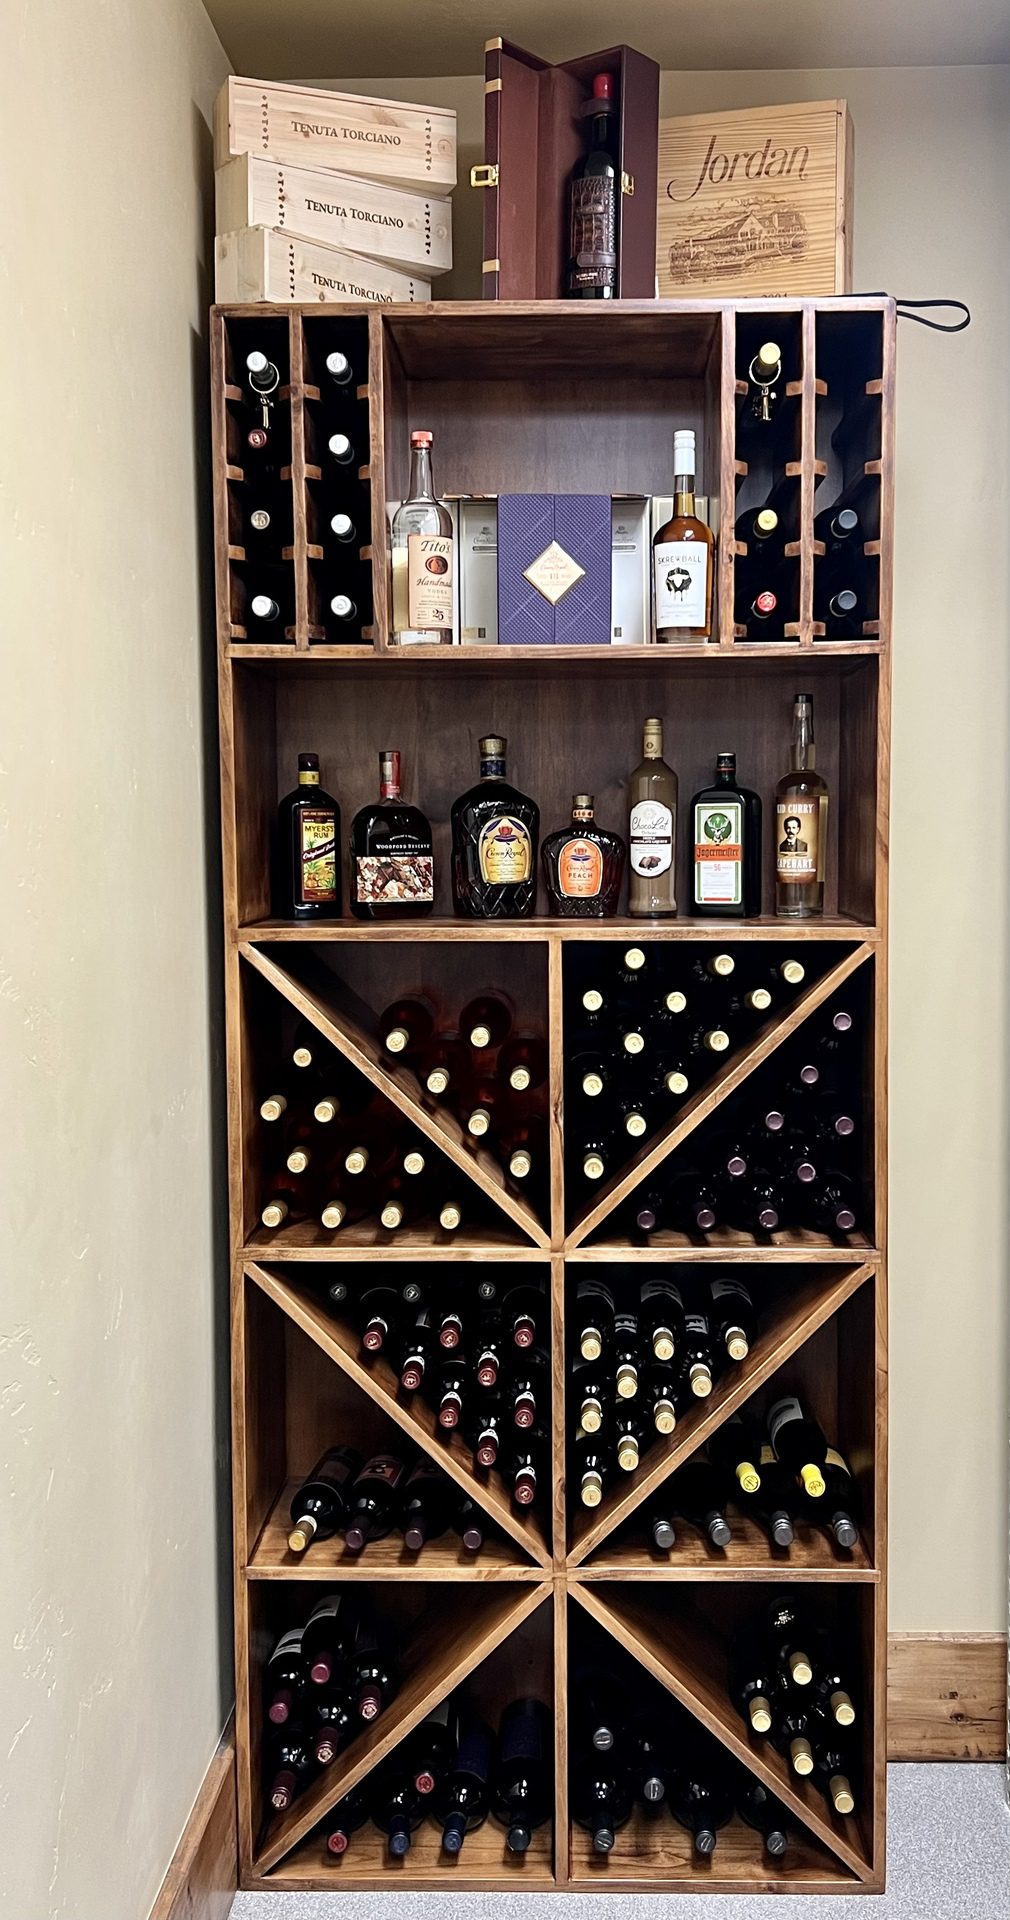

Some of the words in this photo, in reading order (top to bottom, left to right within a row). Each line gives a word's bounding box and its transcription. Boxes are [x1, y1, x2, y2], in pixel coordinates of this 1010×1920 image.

[291, 121, 339, 138] TENUTA
[341, 127, 401, 146] TORCIANO
[667, 135, 809, 202] Jordan
[305, 198, 348, 218] TENUTA
[350, 207, 404, 229] TORCIANO
[311, 272, 347, 293] TENUTA
[348, 283, 393, 303] TORCIANO
[420, 539, 451, 554] Tito's
[657, 555, 702, 565] SKREWBALL
[432, 609, 444, 621] 25
[788, 803, 814, 814] CURRY
